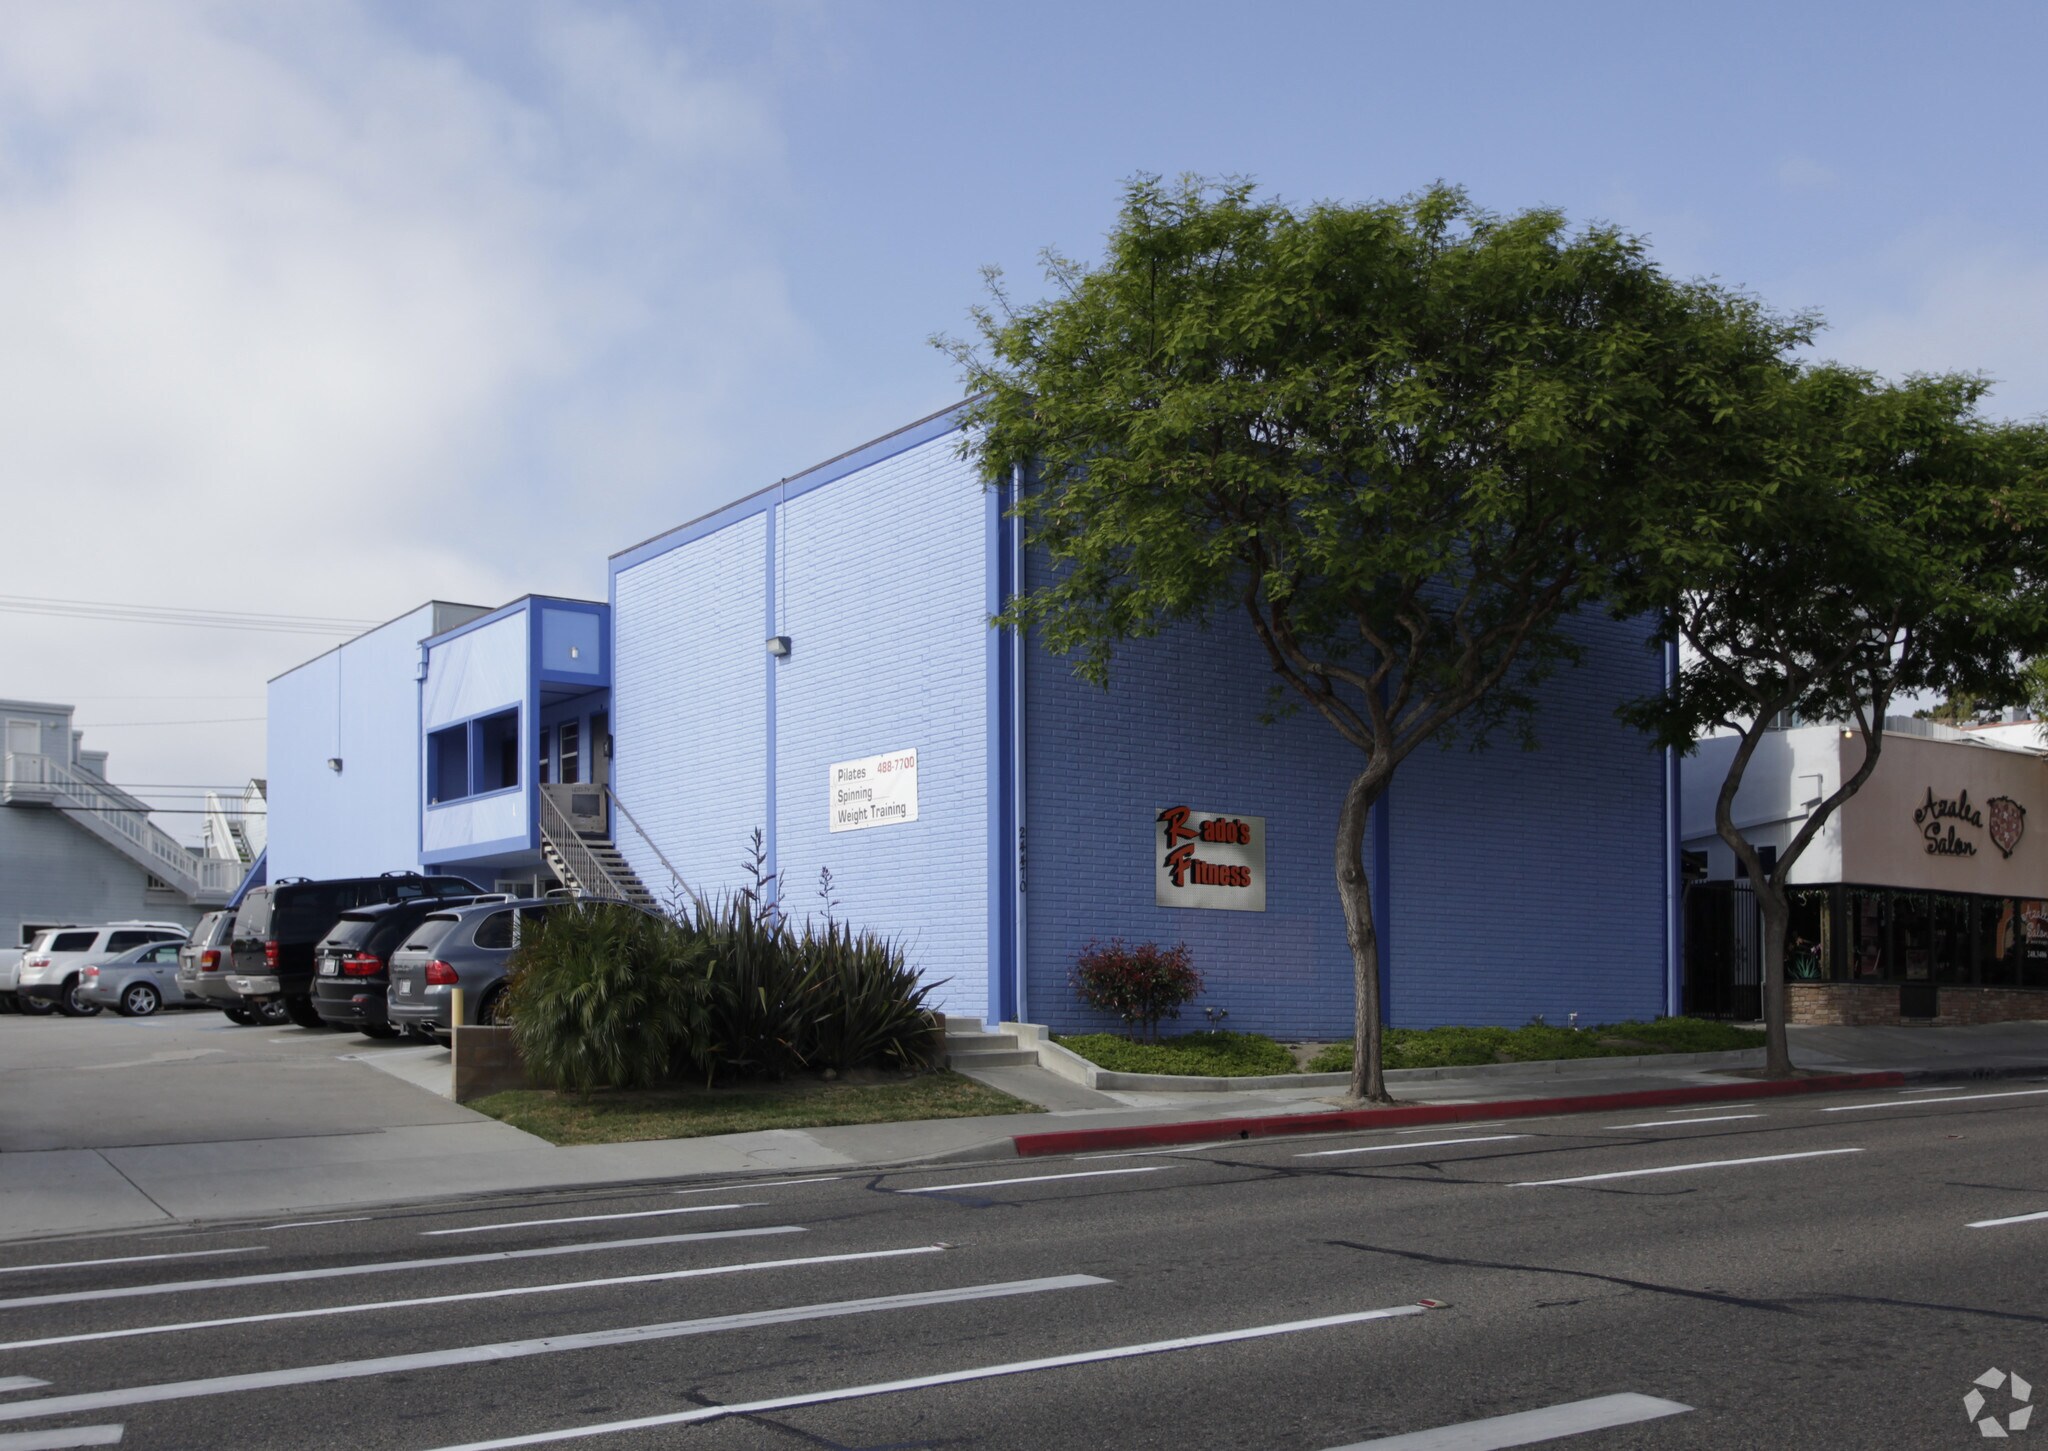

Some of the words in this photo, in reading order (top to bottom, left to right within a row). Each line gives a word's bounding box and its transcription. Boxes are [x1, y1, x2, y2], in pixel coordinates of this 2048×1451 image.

[837, 768, 867, 782] Pilates
[877, 756, 915, 774] 488-7700
[837, 786, 873, 805] Spinning
[1914, 786, 1984, 828] Azalea
[837, 808, 868, 825] Weight
[870, 802, 907, 818] Training
[1156, 805, 1251, 849] Rado's
[1924, 821, 1977, 856] Salon
[1163, 842, 1252, 888] Fitness
